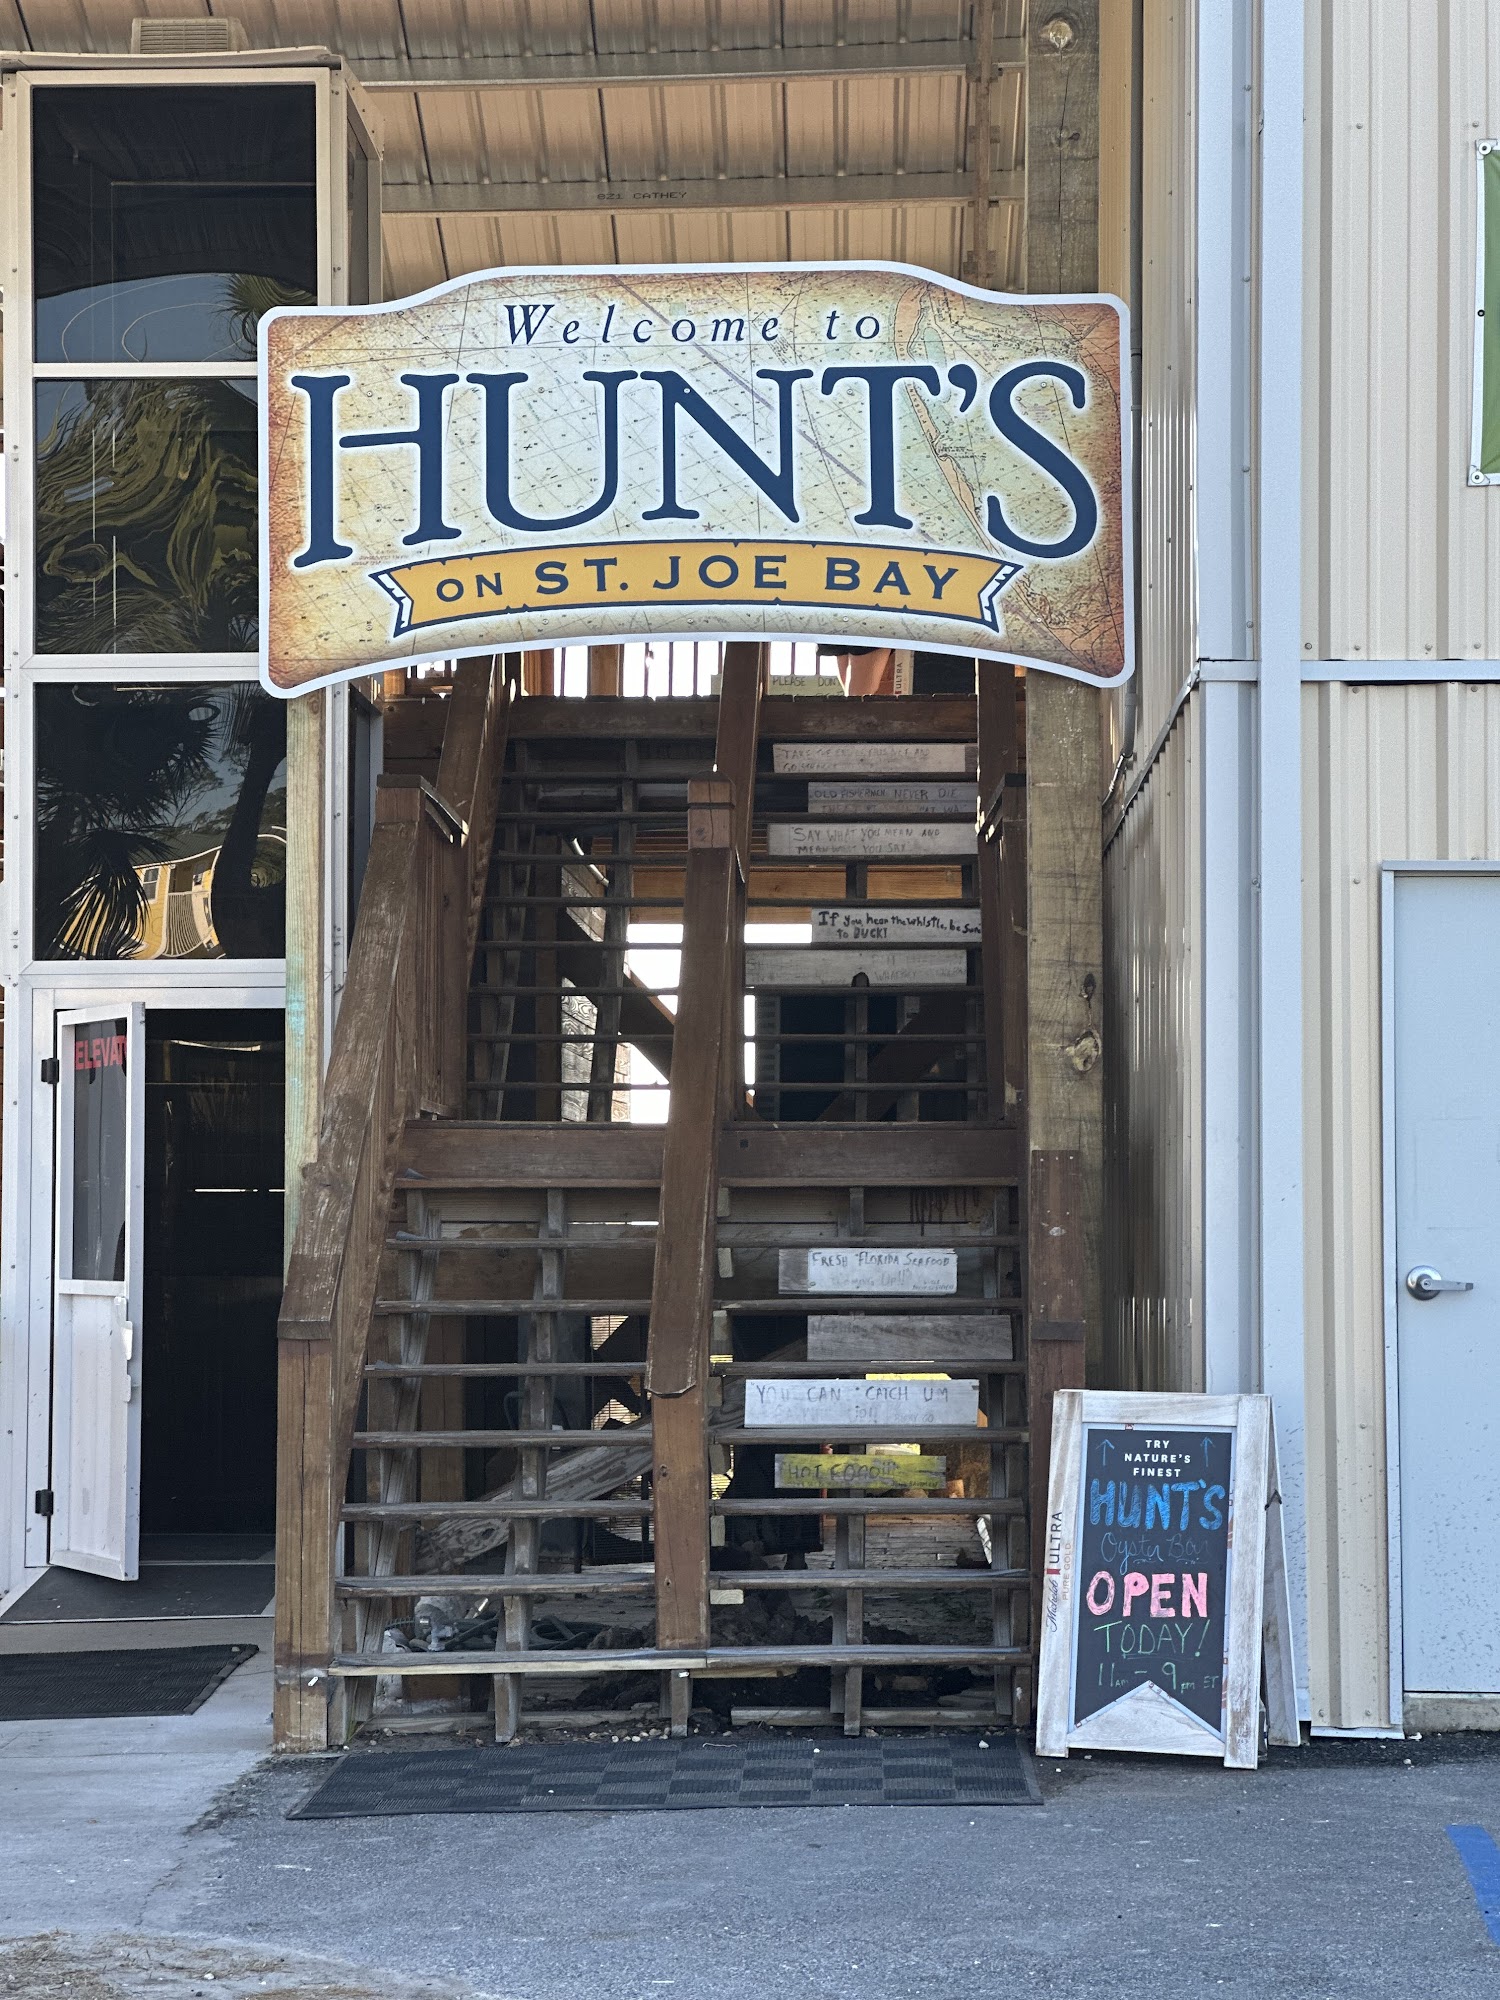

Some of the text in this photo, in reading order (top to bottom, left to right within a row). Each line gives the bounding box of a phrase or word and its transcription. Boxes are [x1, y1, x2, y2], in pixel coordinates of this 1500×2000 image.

[633, 191, 688, 200] CATHEY
[504, 303, 881, 346] Welcome to
[436, 555, 960, 602] ON ST. JOE BAY
[772, 676, 806, 687] PLEASE
[895, 662, 903, 689] ULTRA
[894, 788, 929, 800] NEVER
[937, 787, 958, 799] DIE
[818, 910, 839, 926] If
[866, 912, 889, 925] hear
[949, 918, 961, 931] be
[836, 926, 849, 939] to
[75, 1034, 127, 1070] ELEVAT
[811, 1251, 848, 1268] FRESH
[806, 1386, 842, 1403] CAN
[864, 1385, 908, 1402] CATCH
[923, 1386, 949, 1402] UM
[1145, 1439, 1171, 1450] TRY
[1132, 1467, 1182, 1478] FINEST
[1088, 1477, 1227, 1532] HUNT'S
[1100, 1531, 1165, 1576] Oyster
[1045, 1510, 1063, 1634] Michelob ULTRA
[1062, 1542, 1072, 1602] PURE GOLD
[1086, 1570, 1208, 1618] OPEN
[1093, 1618, 1211, 1658] TODAY!
[1203, 1675, 1219, 1689] ET
